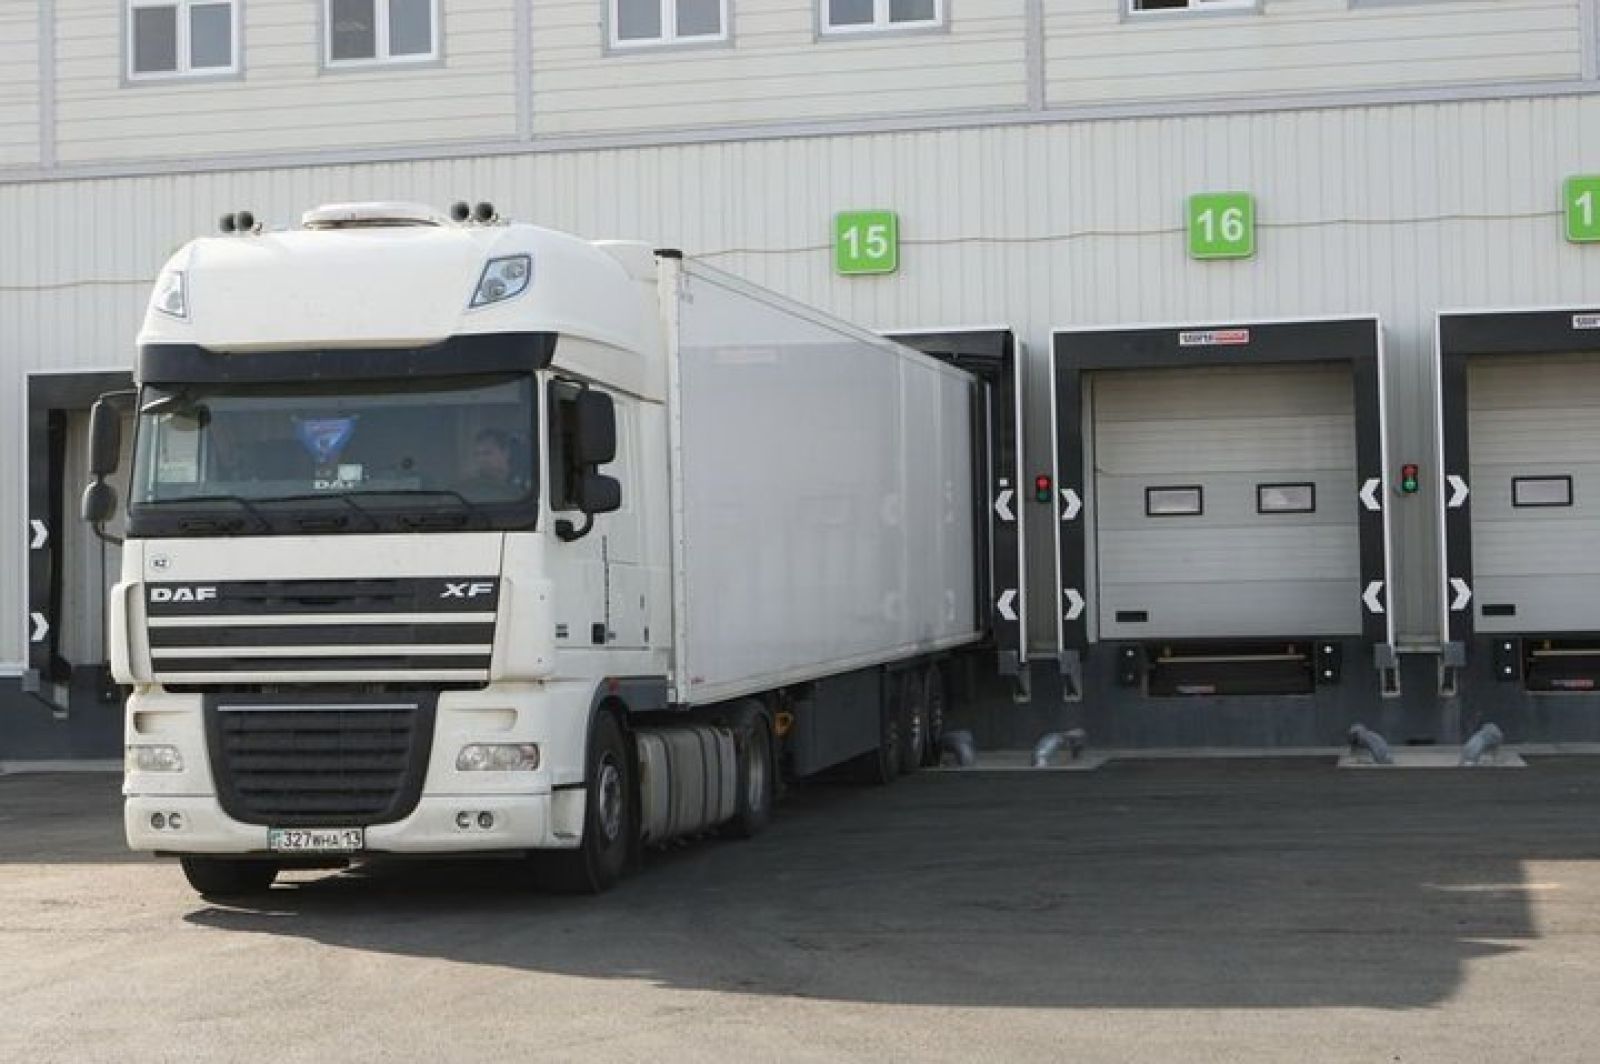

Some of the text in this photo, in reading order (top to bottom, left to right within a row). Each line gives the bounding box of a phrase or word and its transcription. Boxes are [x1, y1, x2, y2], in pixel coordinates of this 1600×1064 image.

[1197, 207, 1243, 242] 16
[841, 225, 888, 259] 15
[150, 586, 217, 602] DAF
[440, 582, 494, 598] XF
